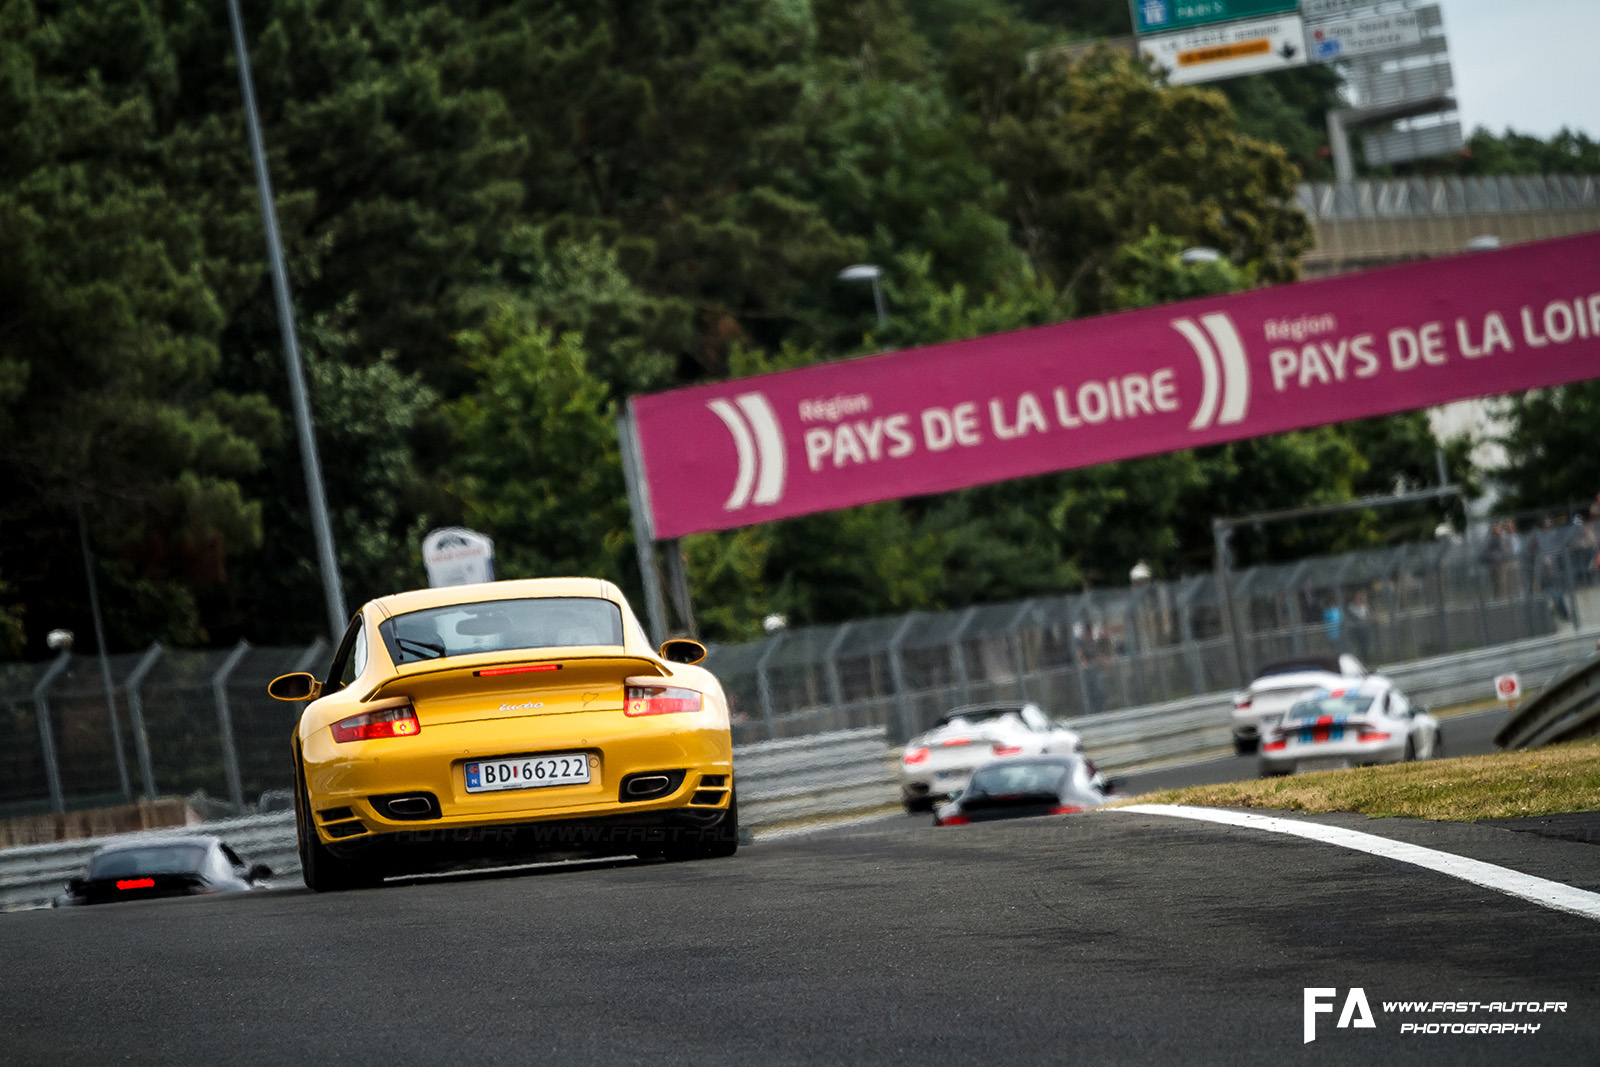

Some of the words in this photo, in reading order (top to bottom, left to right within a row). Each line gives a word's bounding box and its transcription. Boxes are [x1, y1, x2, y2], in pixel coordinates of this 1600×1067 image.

[1265, 315, 1335, 341] Région
[1269, 335, 1380, 391] PAYS
[1389, 323, 1446, 371] DE
[1456, 313, 1512, 357] LA
[799, 394, 870, 421] Région
[805, 415, 914, 471] PAYS
[922, 402, 981, 451] DE
[989, 394, 1048, 440] LA
[1054, 369, 1178, 428] LOIRE
[499, 702, 543, 711] turbo
[484, 764, 511, 784] BD
[522, 758, 584, 780] 66222
